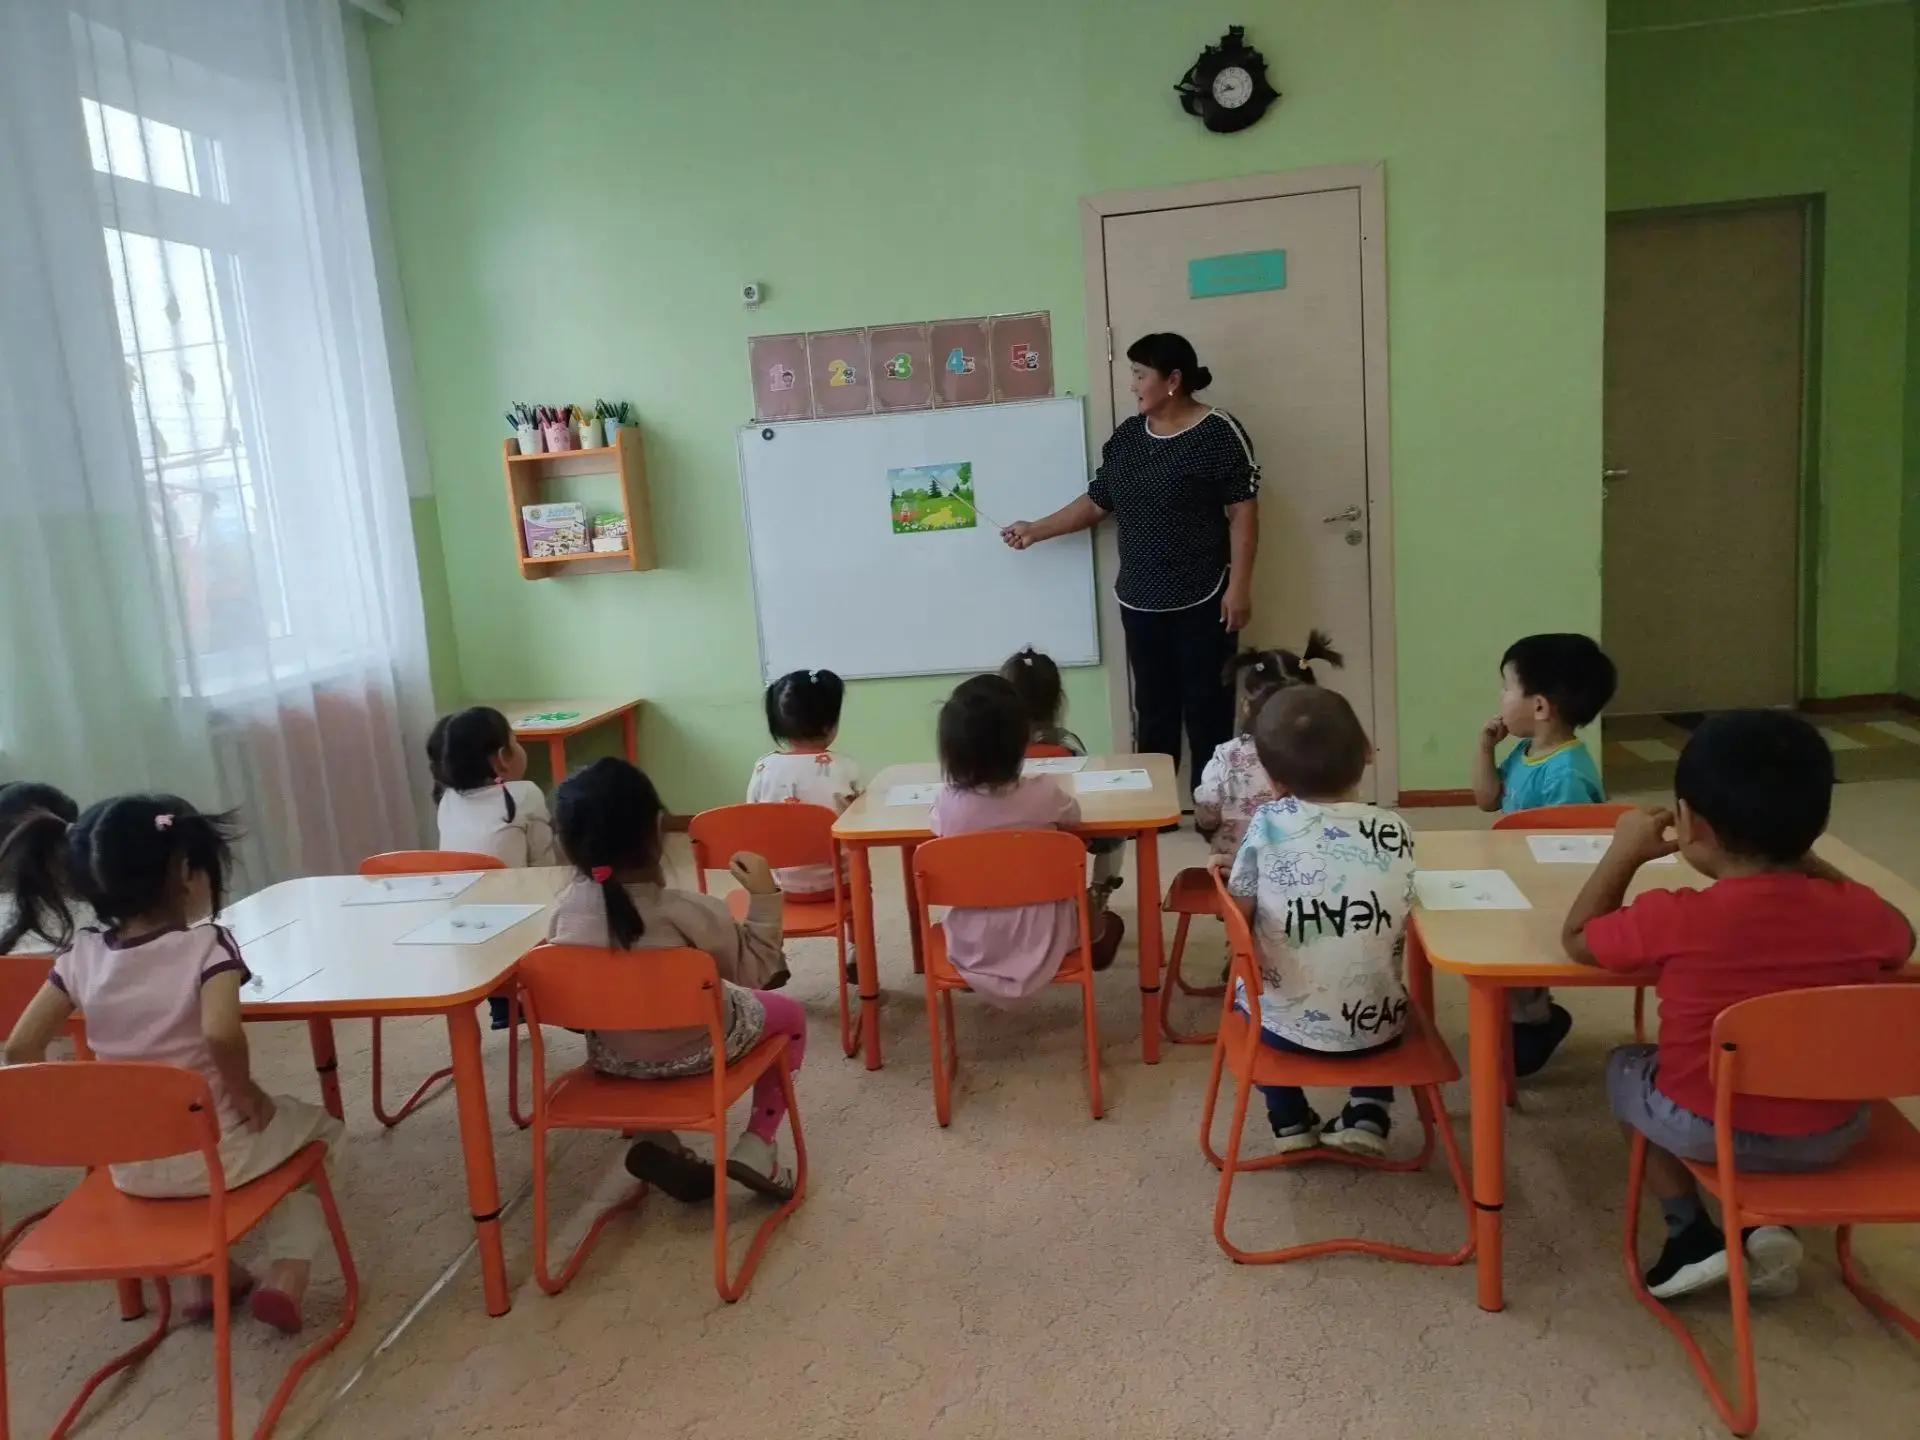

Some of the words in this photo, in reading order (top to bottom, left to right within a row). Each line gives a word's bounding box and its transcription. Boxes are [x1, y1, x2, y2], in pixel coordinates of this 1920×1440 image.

[894, 353, 912, 379] 3
[946, 348, 965, 374] 4
[1011, 344, 1030, 371] 5
[769, 364, 789, 391] 1
[828, 360, 849, 387] 2
[1273, 859, 1299, 873] GET
